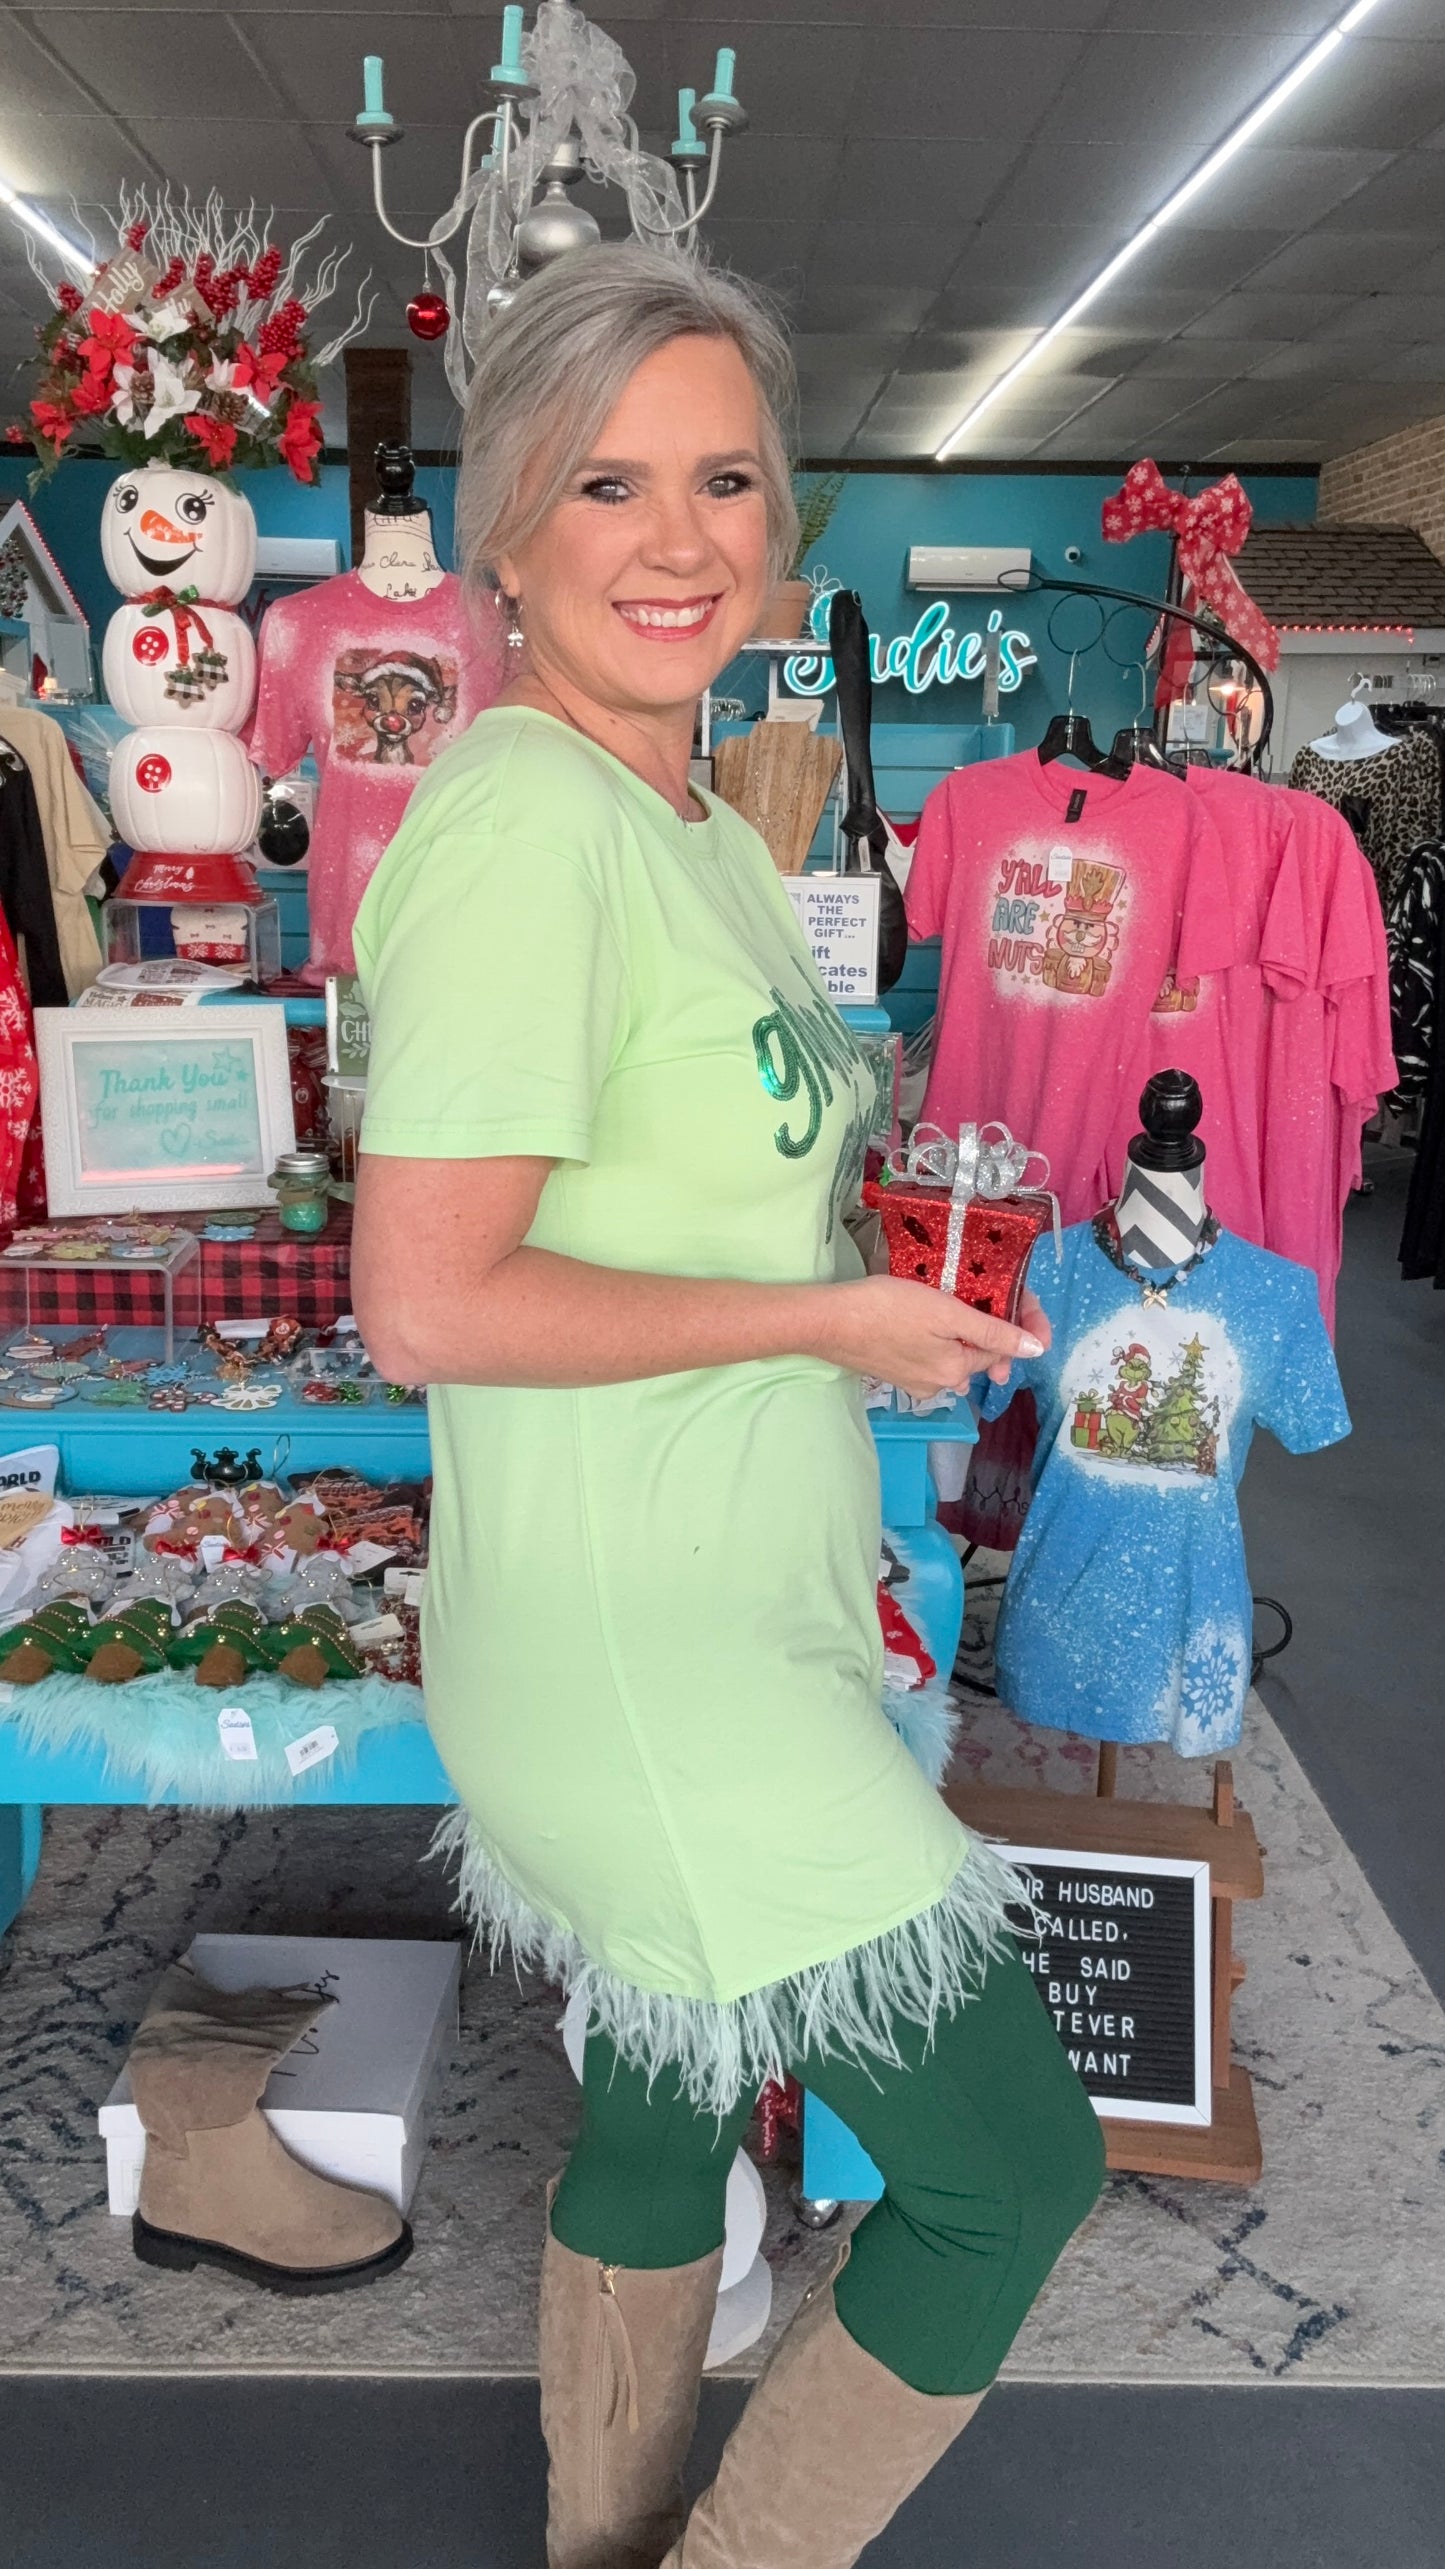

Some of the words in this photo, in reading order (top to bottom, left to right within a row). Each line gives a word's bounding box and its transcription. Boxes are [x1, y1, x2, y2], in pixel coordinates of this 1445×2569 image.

[134, 875, 196, 894] Christmas
[997, 858, 1063, 899] Y'ALL
[806, 893, 860, 905] ALWAYS
[817, 905, 844, 915] THE
[807, 916, 867, 928] PERFECT
[991, 897, 1040, 936] ARE
[813, 928, 856, 939] GIFT...
[987, 937, 1045, 976] NUTS
[99, 1066, 176, 1100] Thank
[181, 1063, 230, 1094] You
[86, 1100, 119, 1130] for
[129, 1097, 199, 1125] shopping
[206, 1089, 249, 1112] small
[1058, 1880, 1154, 1909] HUSBAND
[1034, 1914, 1128, 1943] CALLED,
[1080, 1956, 1131, 1981] SAID
[1048, 1981, 1097, 2006] BUY
[1053, 2010, 1135, 2039] TEVER
